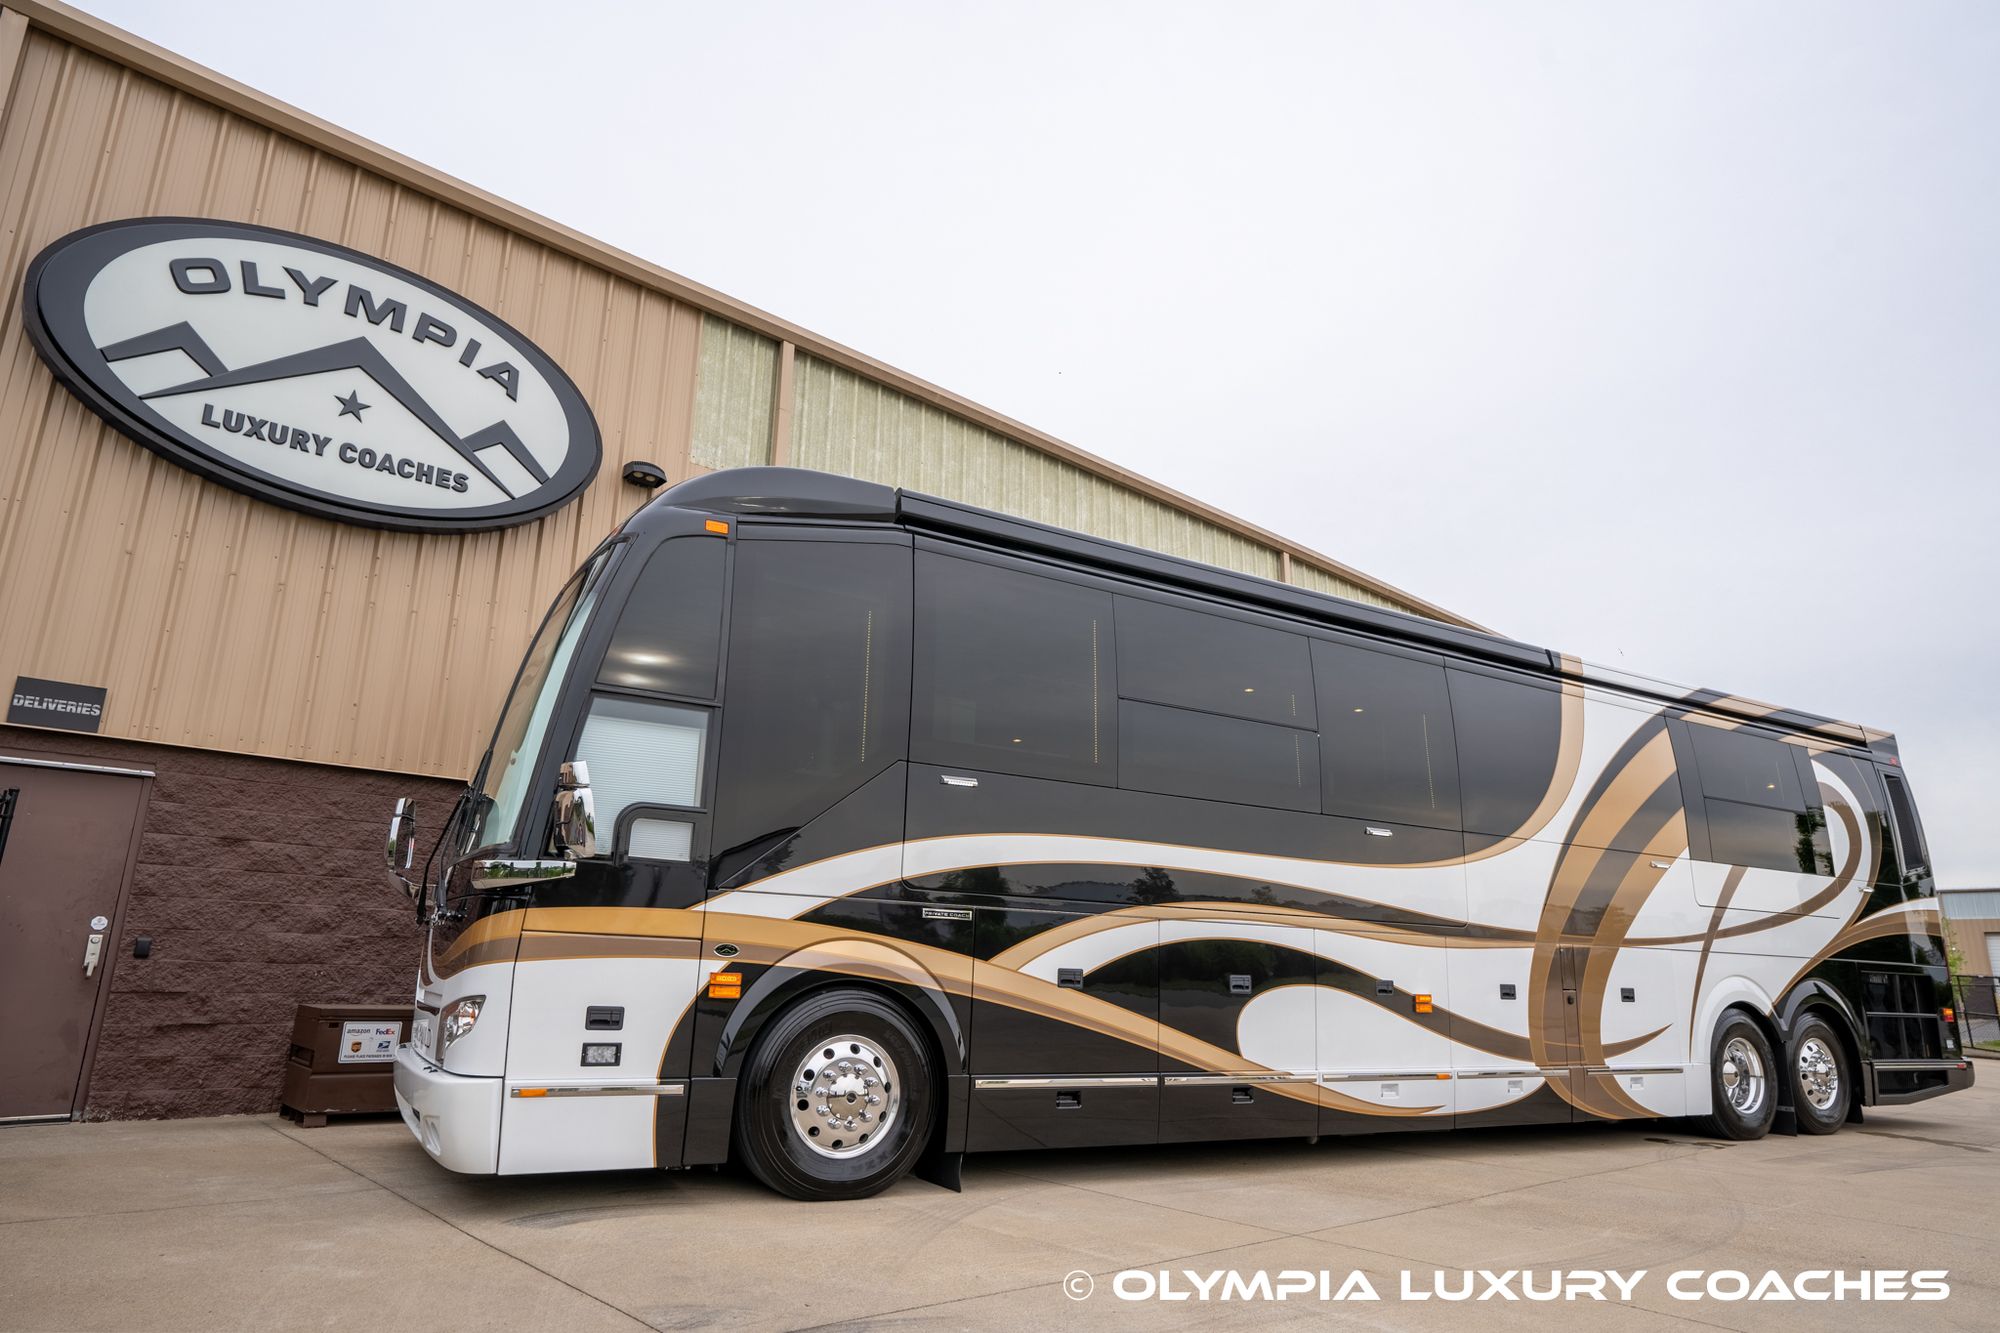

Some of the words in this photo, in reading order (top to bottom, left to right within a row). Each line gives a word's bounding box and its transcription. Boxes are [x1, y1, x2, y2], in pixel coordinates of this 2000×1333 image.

[169, 257, 521, 402] OLYMPIA
[201, 403, 333, 457] LUXURY
[338, 442, 470, 494] COACHES
[12, 694, 101, 716] DELIVERIES
